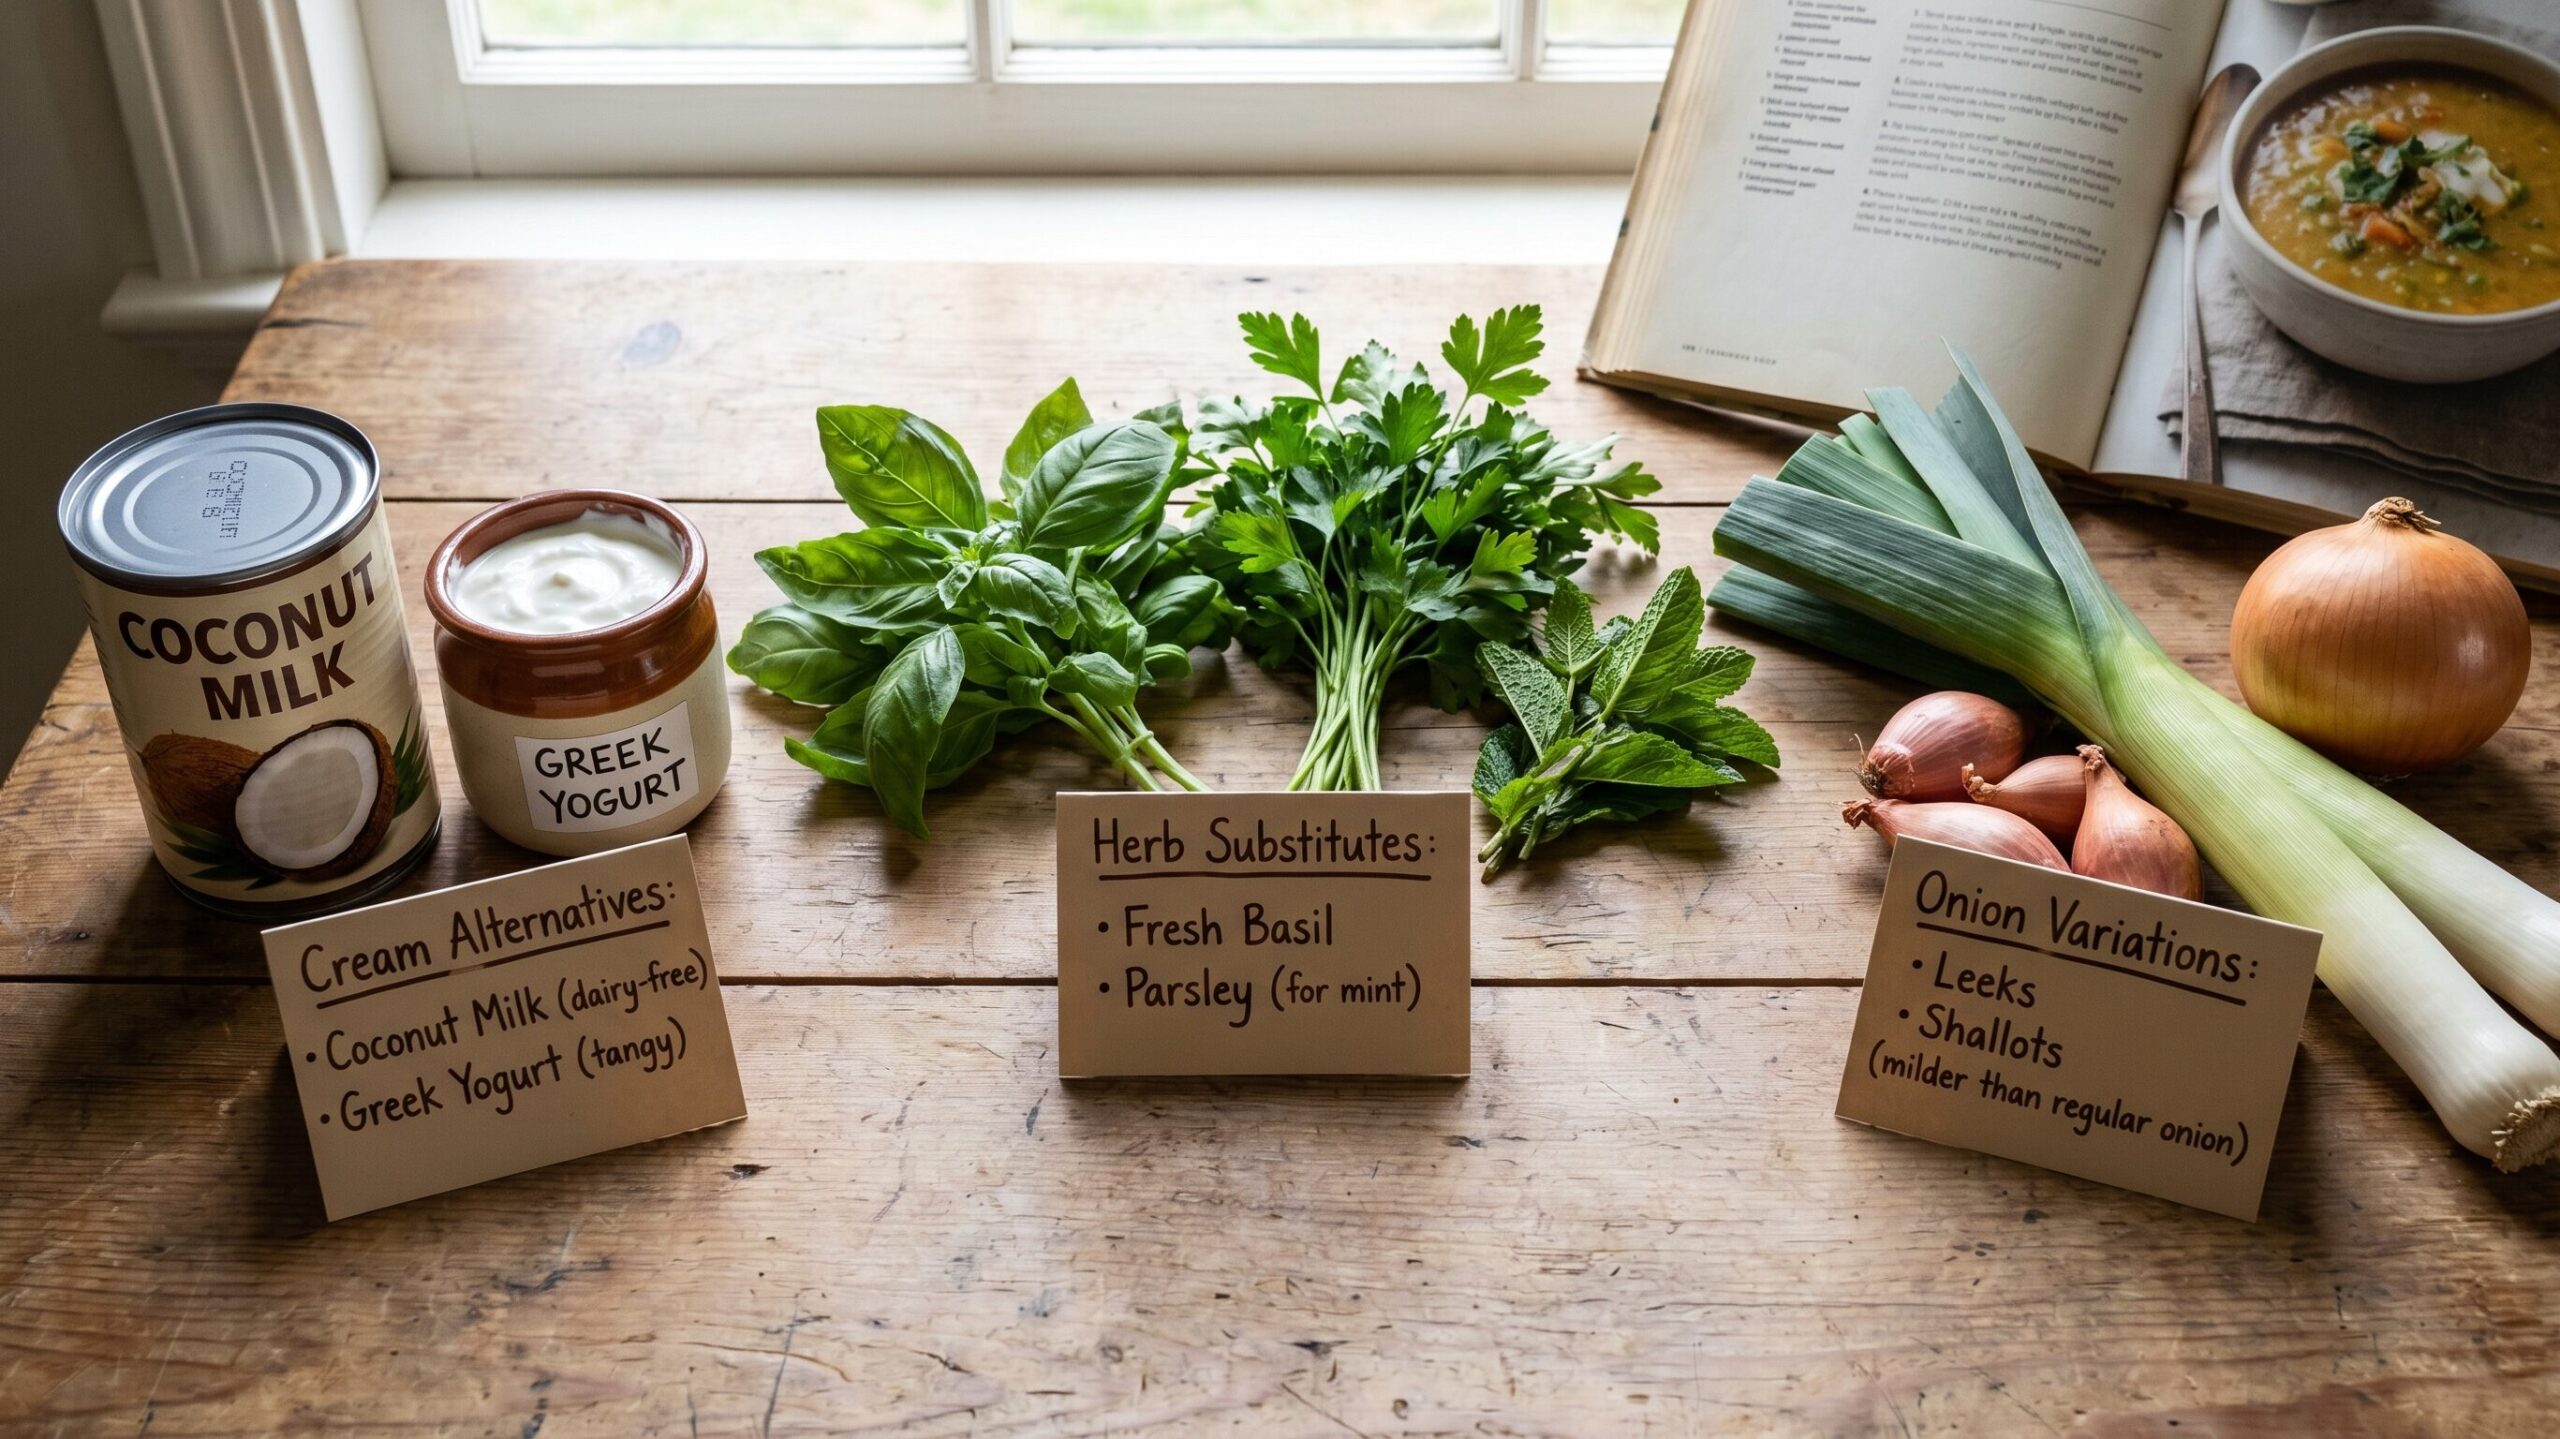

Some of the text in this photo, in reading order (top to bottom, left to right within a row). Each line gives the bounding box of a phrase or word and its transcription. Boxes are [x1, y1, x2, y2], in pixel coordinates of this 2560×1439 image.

[118, 551, 376, 665] COCONUT
[199, 640, 355, 721] MILK
[535, 727, 670, 780] GREEK
[539, 758, 686, 825] YOGURT
[1093, 816, 1436, 864] Herb Substitutes:
[301, 881, 676, 993] Cream Alternatives:
[1124, 902, 1333, 946] Fresh Basil
[1915, 869, 2259, 983] Onion Variations:
[325, 947, 708, 1071] Coconut Milk (dairy-free)
[1125, 962, 1421, 1028] Parsley (for mint)
[1933, 950, 2036, 1008] Leeks
[1918, 1004, 2064, 1069] Shallots
[340, 1016, 687, 1132] Greek Yogurt (tangy)
[1868, 1039, 2249, 1167] (milder than regular onion)
